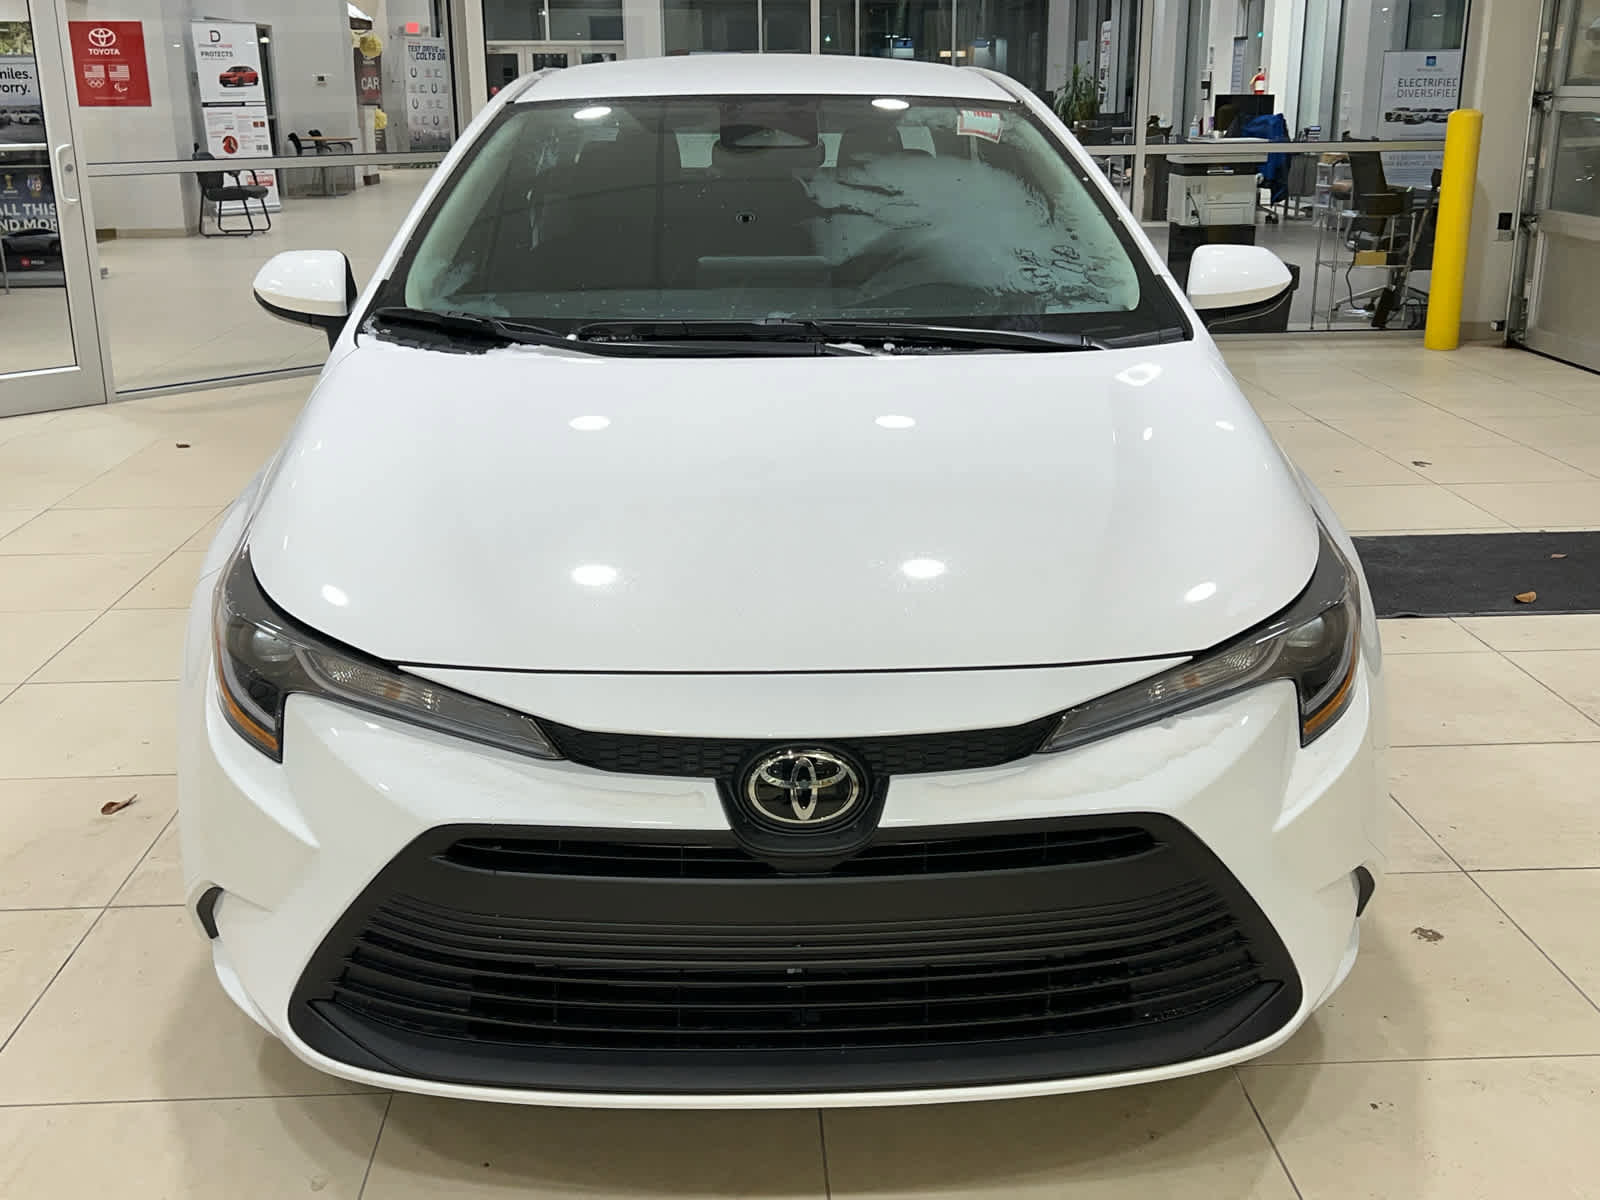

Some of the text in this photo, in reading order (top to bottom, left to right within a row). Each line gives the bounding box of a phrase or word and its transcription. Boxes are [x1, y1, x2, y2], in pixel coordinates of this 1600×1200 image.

[88, 48, 120, 56] TOYOTA
[422, 45, 439, 53] DRIVE
[416, 52, 435, 60] COLTS
[361, 77, 380, 89] CAR
[0, 84, 31, 96] orry.
